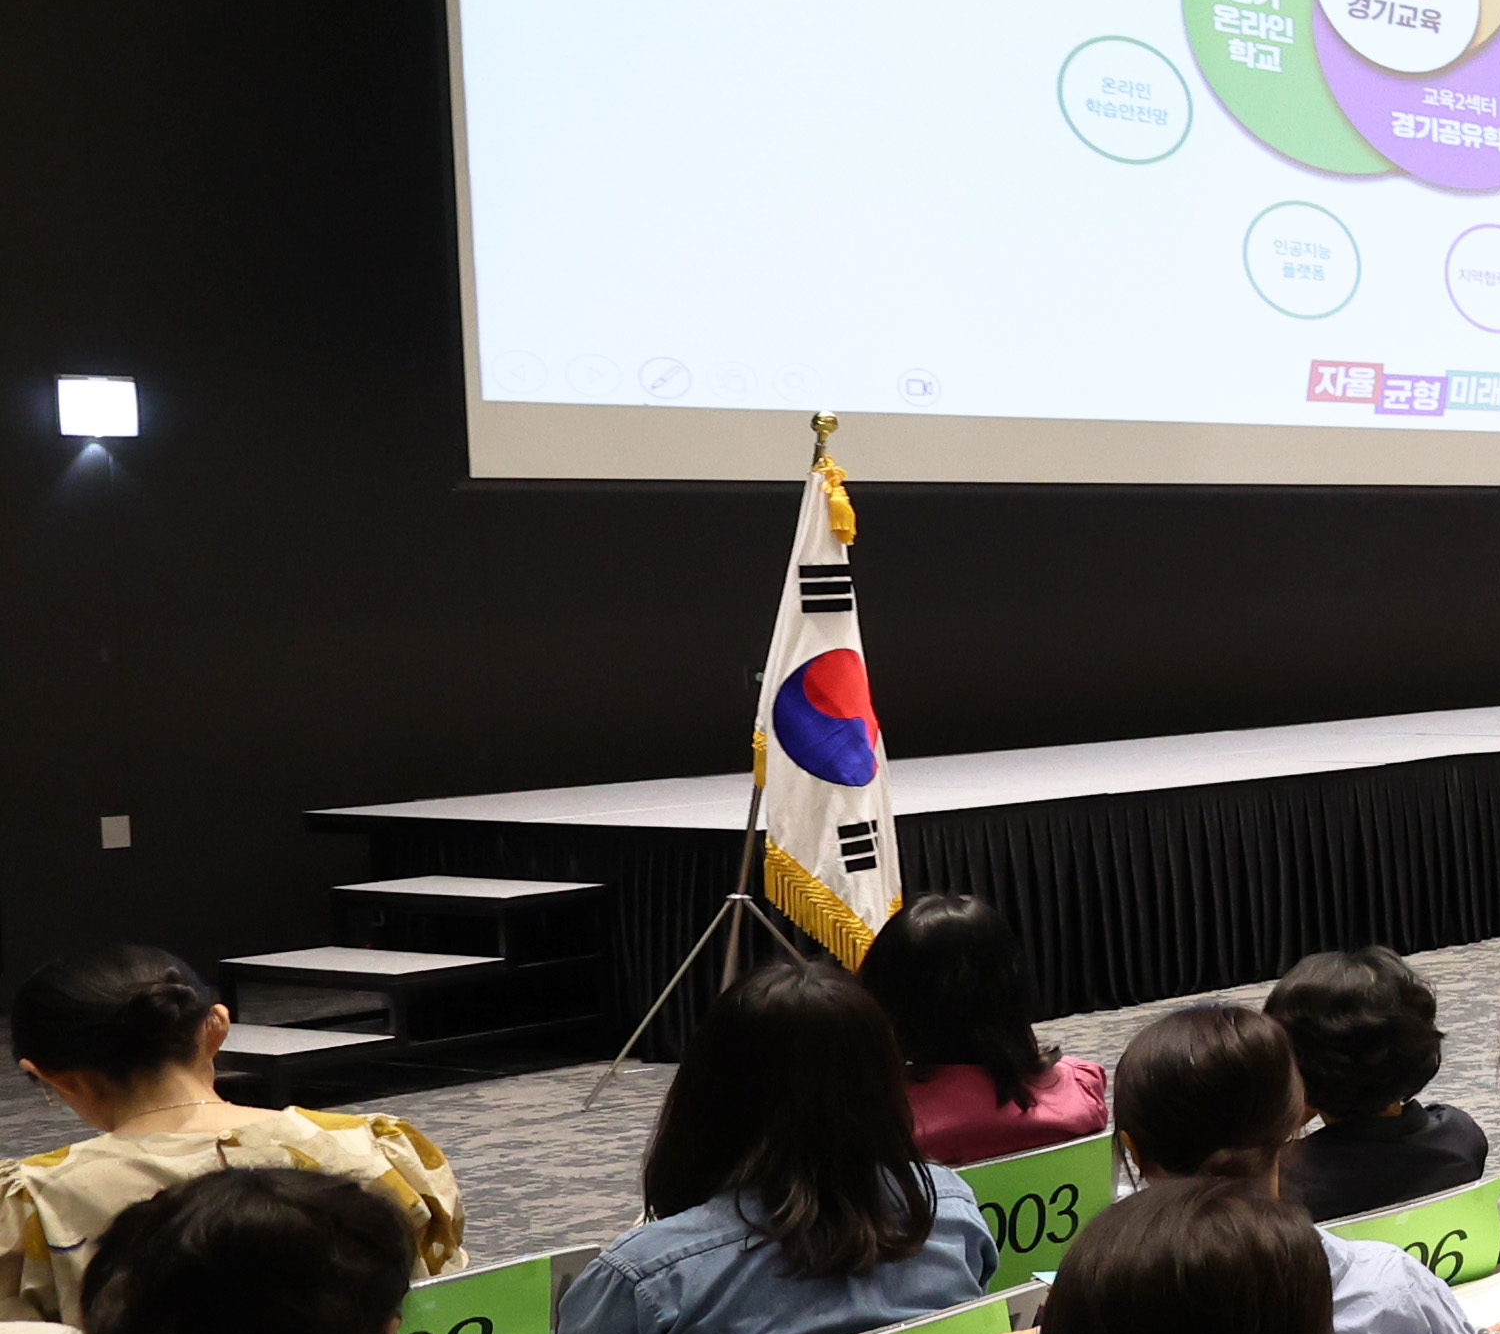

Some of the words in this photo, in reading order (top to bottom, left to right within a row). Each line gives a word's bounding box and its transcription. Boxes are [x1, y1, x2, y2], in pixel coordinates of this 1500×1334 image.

[1212, 3, 1296, 44] 온라인
[1226, 38, 1283, 73] 학교
[1100, 75, 1151, 100] 온라인
[1421, 87, 1498, 118] 교육2섹터
[1085, 96, 1168, 127] 학습안전망
[1273, 239, 1332, 260] 인공지능
[1282, 261, 1325, 281] 플랫폼
[1314, 365, 1376, 399] 자율
[1382, 378, 1441, 411] 균형
